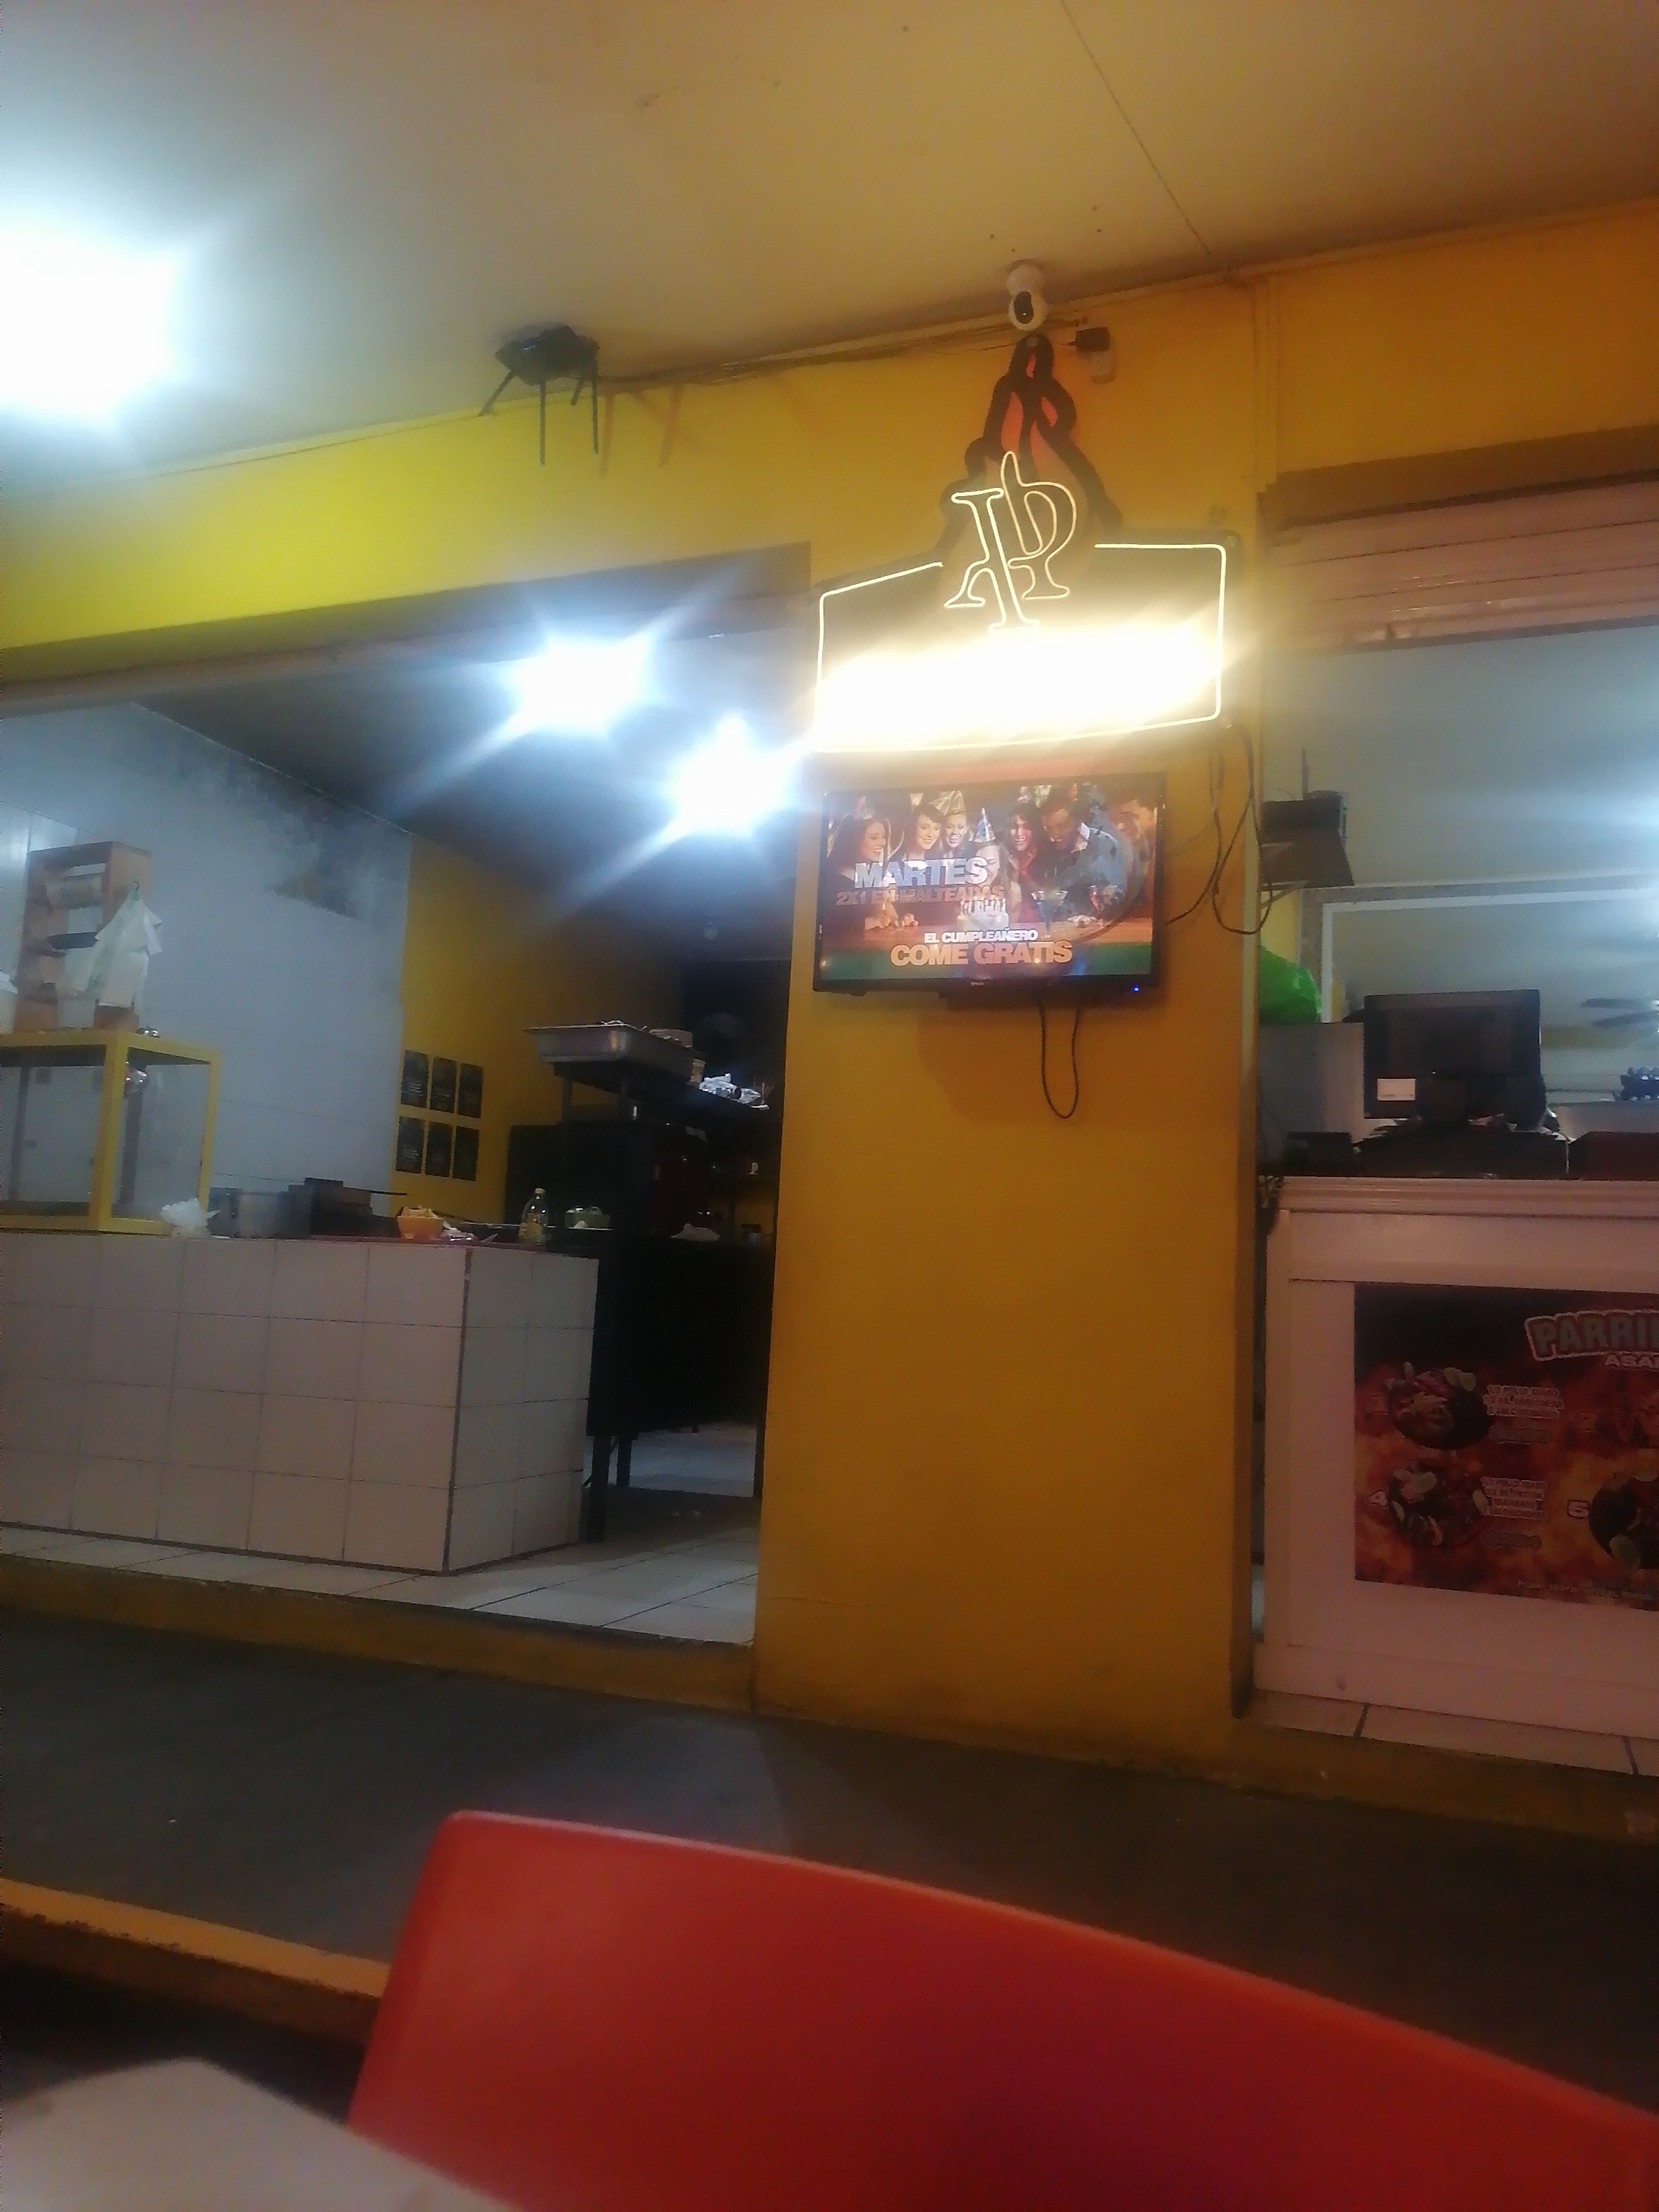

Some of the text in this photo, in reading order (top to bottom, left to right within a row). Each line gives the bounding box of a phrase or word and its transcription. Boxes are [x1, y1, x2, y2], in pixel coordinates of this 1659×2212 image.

[855, 857, 987, 888] MARTES
[836, 885, 1004, 905] 2X1 EN MALTEADAS
[924, 928, 1038, 943] EL CUMPLEAÑERO
[891, 939, 1072, 966] COME GRATIS
